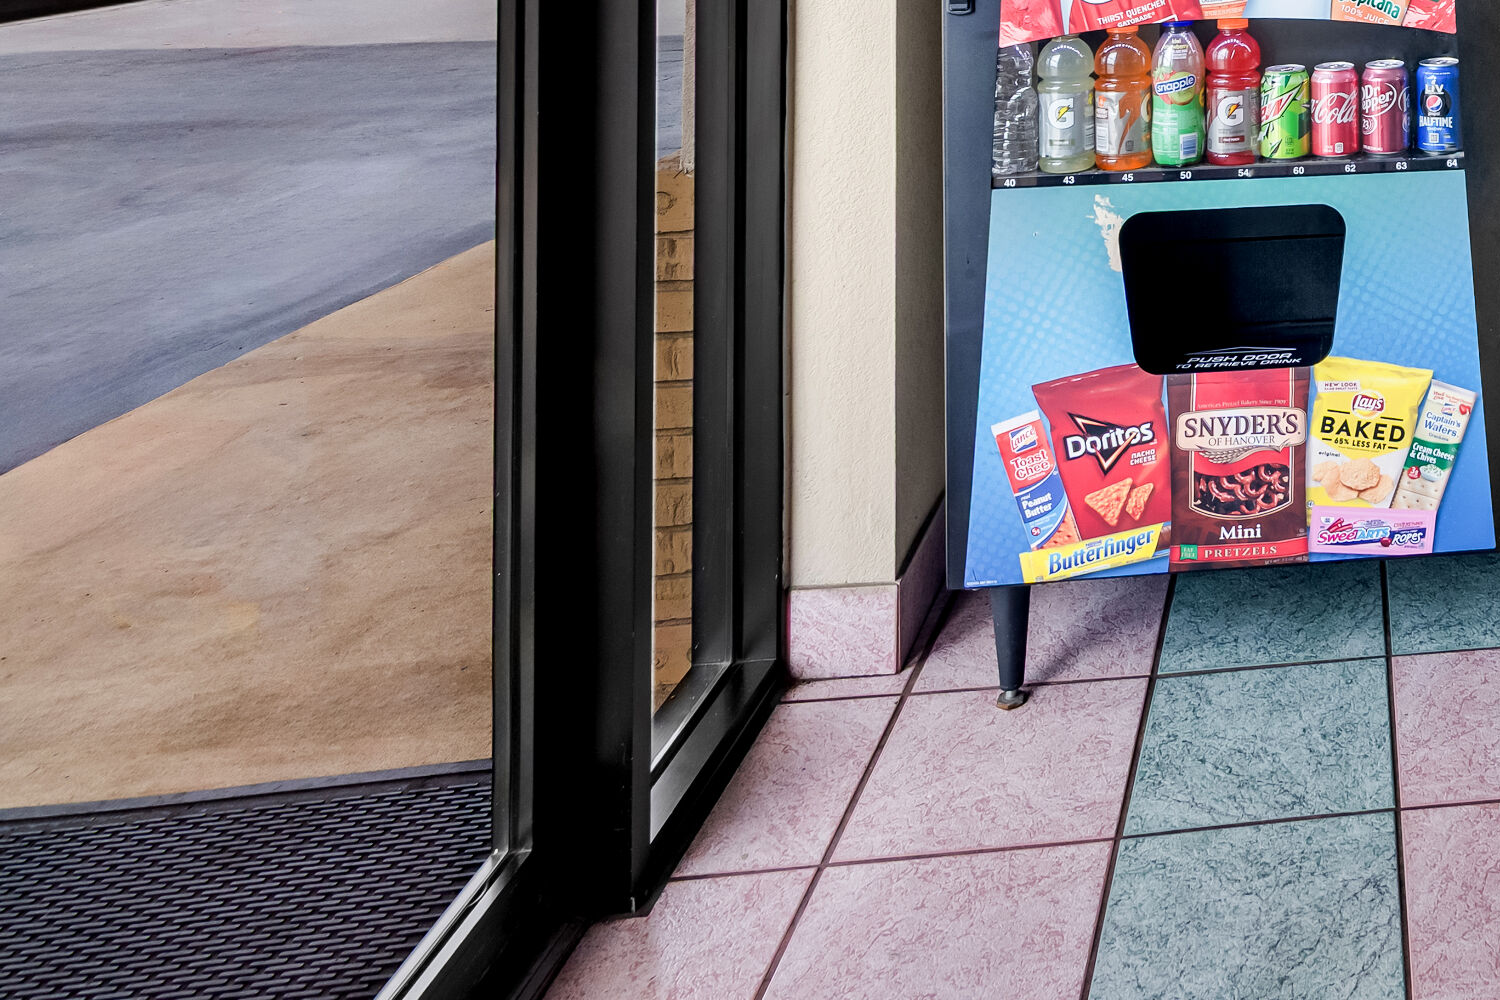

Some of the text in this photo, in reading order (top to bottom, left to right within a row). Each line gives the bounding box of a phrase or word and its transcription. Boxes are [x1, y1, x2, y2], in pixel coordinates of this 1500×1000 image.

[1097, 11, 1124, 25] THIRST
[1341, 5, 1389, 24] 100% JUICE
[1156, 78, 1195, 92] snapple
[1365, 85, 1380, 97] Dr
[1362, 90, 1392, 113] epper
[1048, 98, 1074, 129] G
[1218, 96, 1244, 126] G
[1419, 116, 1452, 128] HALFTIME
[1396, 162, 1407, 170] 63
[1447, 159, 1457, 167] 64
[1004, 179, 1015, 187] 40
[1063, 176, 1074, 184] 43
[1122, 174, 1133, 182] 45
[1180, 172, 1191, 180] 50
[1242, 353, 1292, 361] DOOR
[1184, 412, 1298, 438] SNYDER'S
[1321, 416, 1405, 442] BAKED
[1011, 428, 1036, 449] Lance
[1067, 423, 1154, 459] Doritos
[1209, 435, 1275, 446] OF HANOVER
[1352, 440, 1370, 448] LESS
[1373, 442, 1386, 450] FAT
[1131, 449, 1155, 458] NACHO
[1410, 450, 1436, 464] & Chives
[1413, 442, 1454, 461] Cream Cheese
[1011, 450, 1048, 469] Toast
[1130, 454, 1156, 466] CHEESE
[1015, 461, 1050, 480] Chee
[1022, 493, 1052, 510] Peanut
[1025, 503, 1052, 519] Butter
[1219, 524, 1261, 540] Mini
[1049, 531, 1154, 575] Butterfinger
[1204, 546, 1277, 558] PRETZELS
